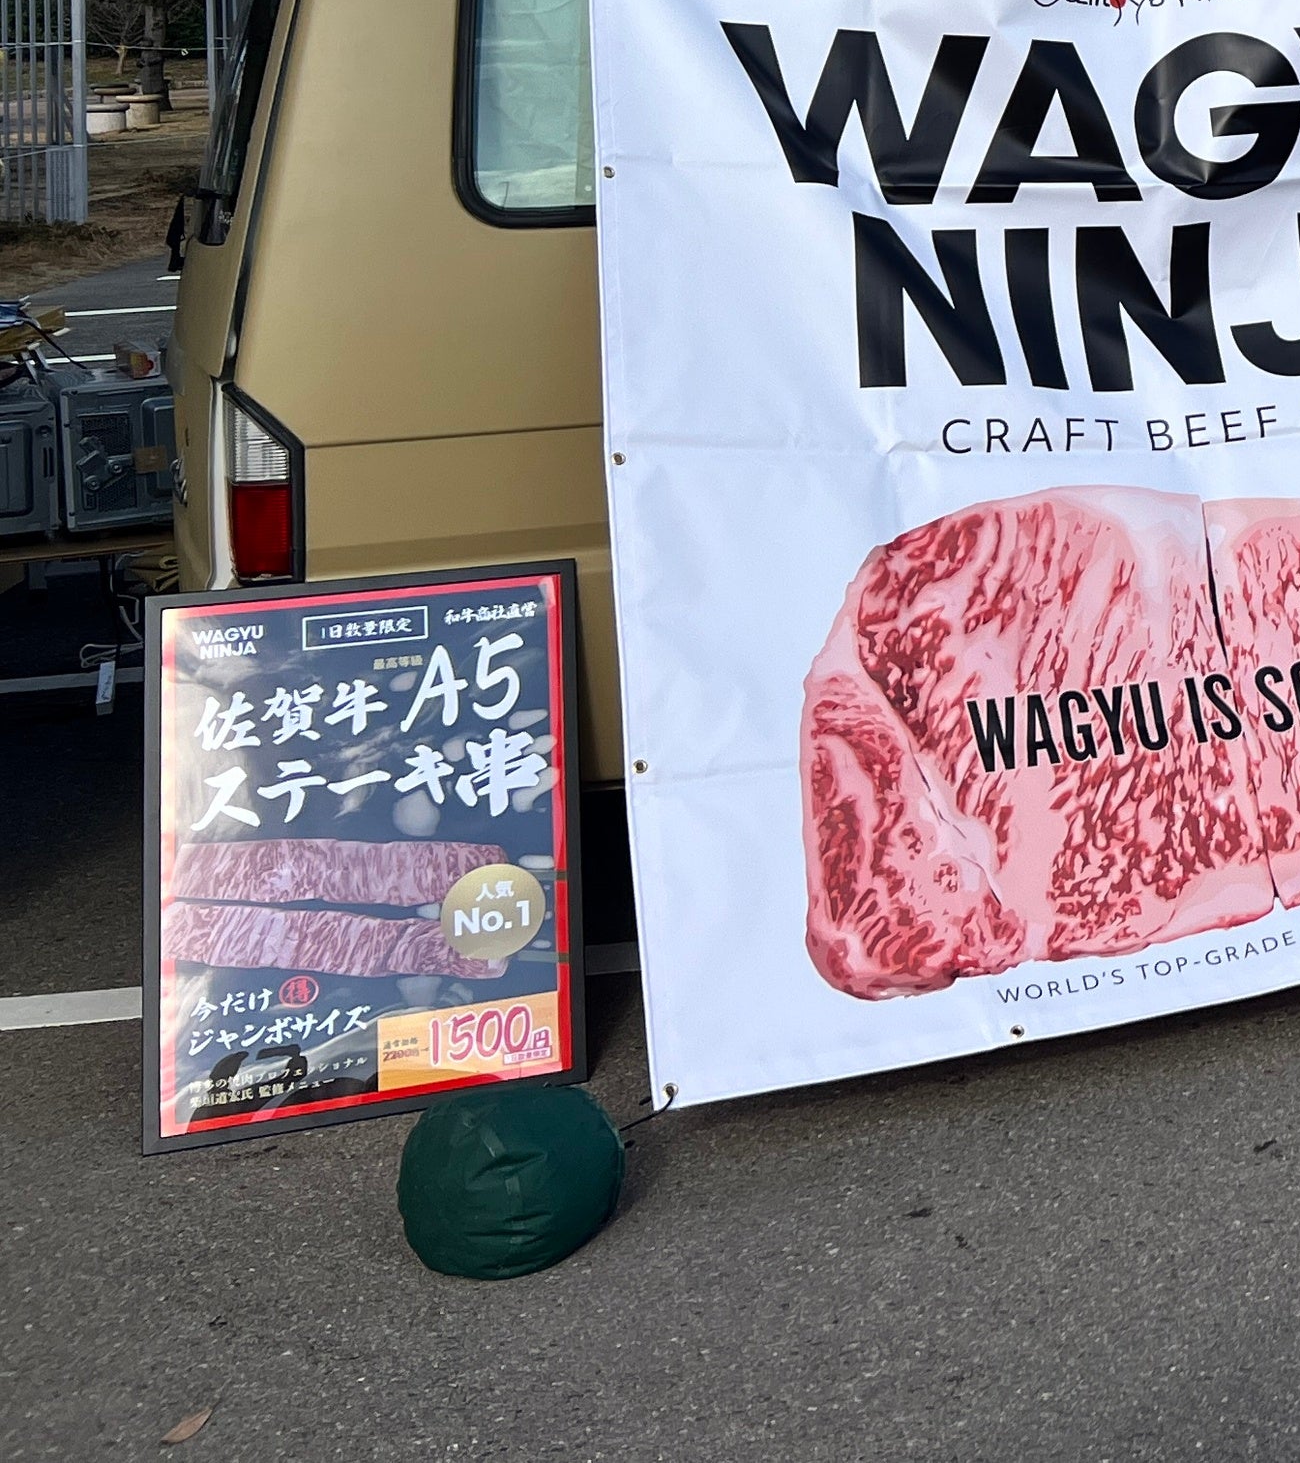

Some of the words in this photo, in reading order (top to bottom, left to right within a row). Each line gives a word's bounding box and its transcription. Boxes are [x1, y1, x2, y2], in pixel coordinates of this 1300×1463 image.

[942, 418, 1119, 455] CRAFT
[1146, 404, 1278, 451] BEEF
[191, 625, 264, 645] WAGYU
[199, 641, 257, 661] NINJA
[194, 679, 388, 751] 佐賀牛
[400, 633, 525, 734] A5
[967, 679, 1169, 774] WAGYU
[1182, 673, 1243, 744] IS
[190, 728, 549, 831] ステーキ串
[475, 880, 515, 901] 人気
[454, 900, 531, 937] No.1
[997, 967, 1125, 1005] WORLD'S
[1134, 930, 1296, 981] TOP-GRADE
[188, 1005, 371, 1056] ジャンボサイズ
[191, 988, 273, 1023] 今だけ
